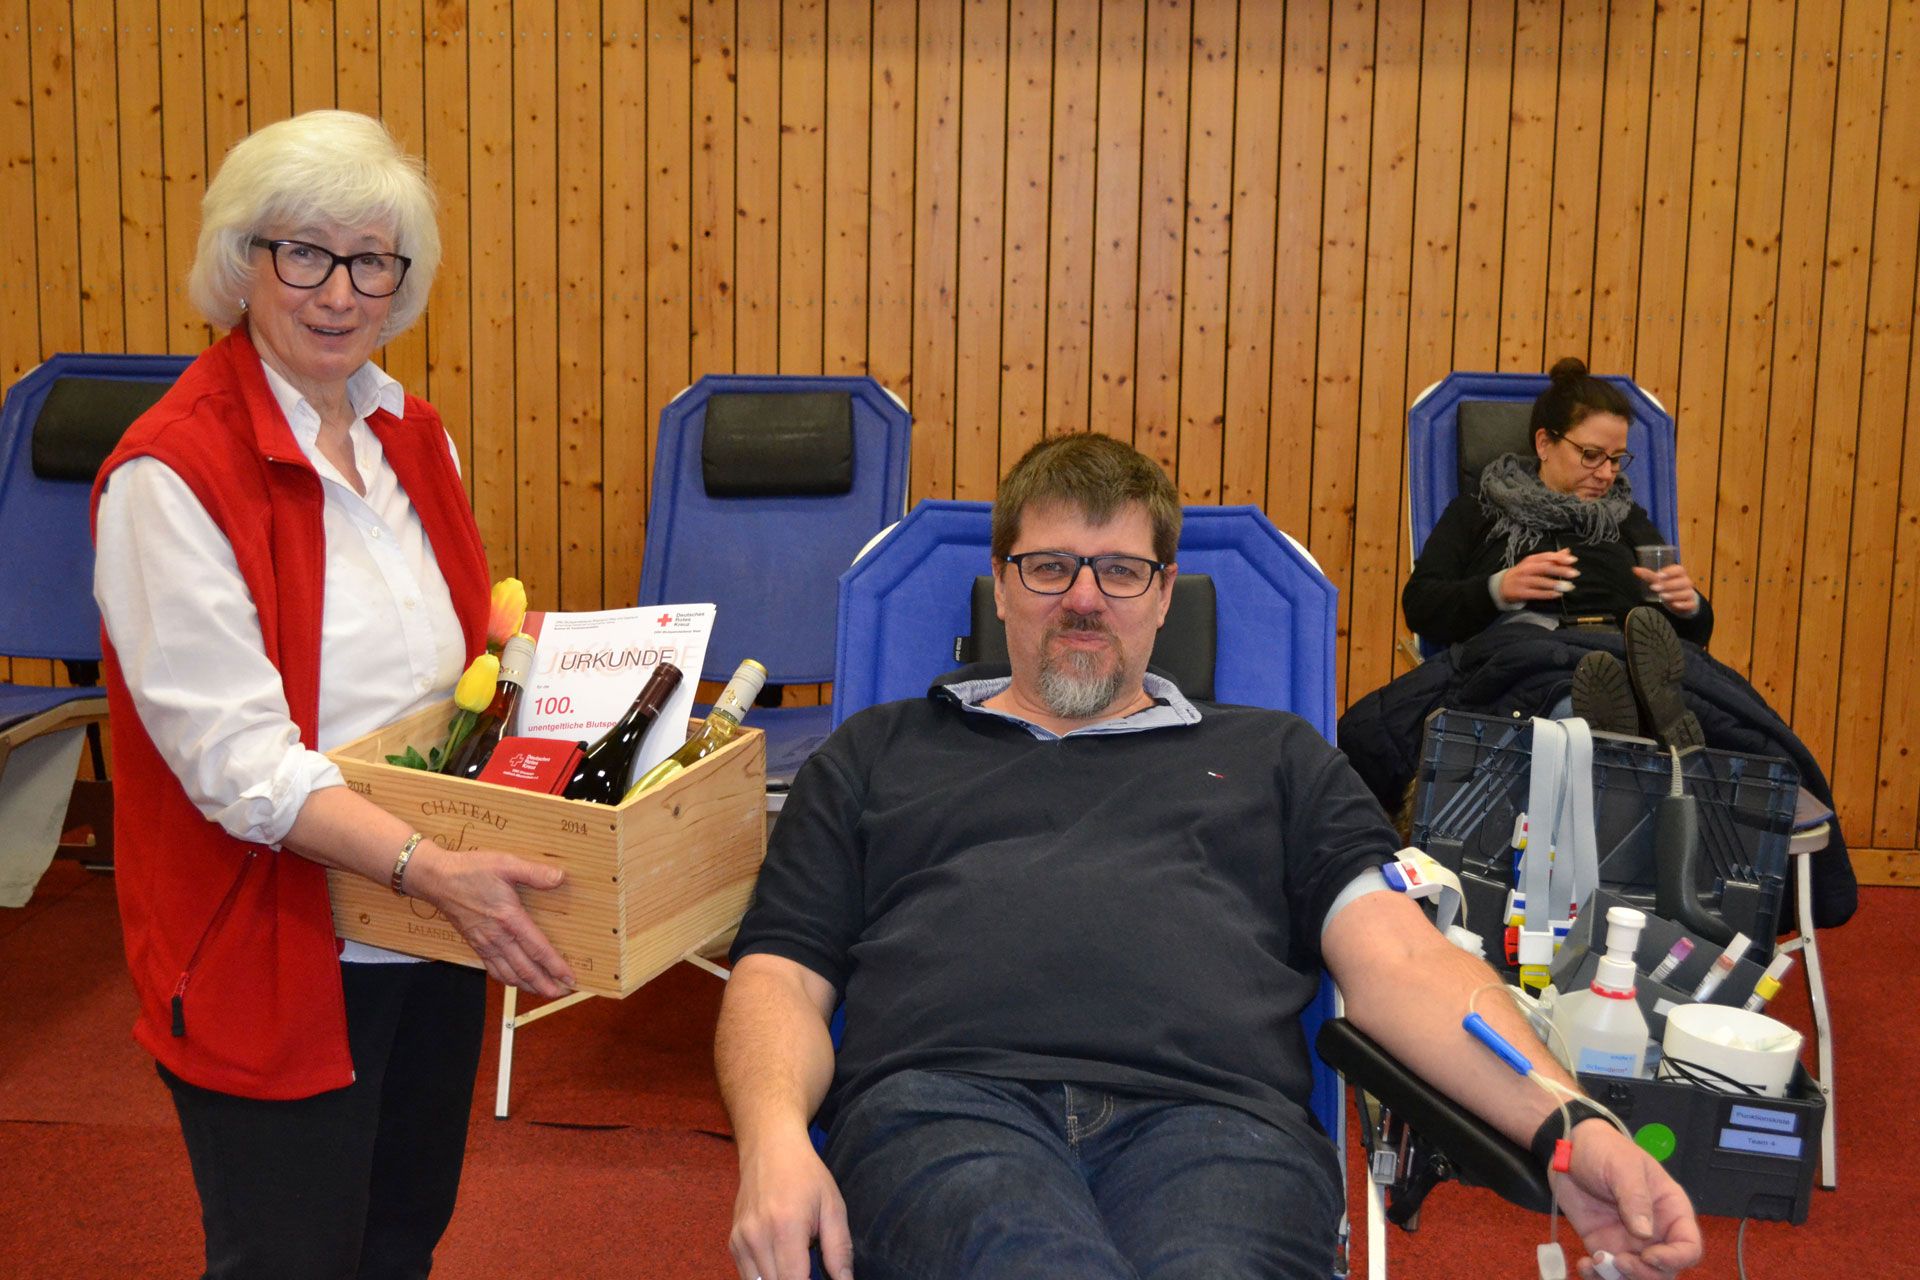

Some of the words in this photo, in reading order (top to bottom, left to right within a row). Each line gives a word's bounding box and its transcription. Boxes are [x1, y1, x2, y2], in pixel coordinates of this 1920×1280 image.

[560, 649, 674, 671] URKUNDE
[534, 696, 575, 716] 100.
[527, 721, 585, 732] unentgeltliche
[347, 780, 373, 795] 2014
[560, 819, 588, 836] 2014
